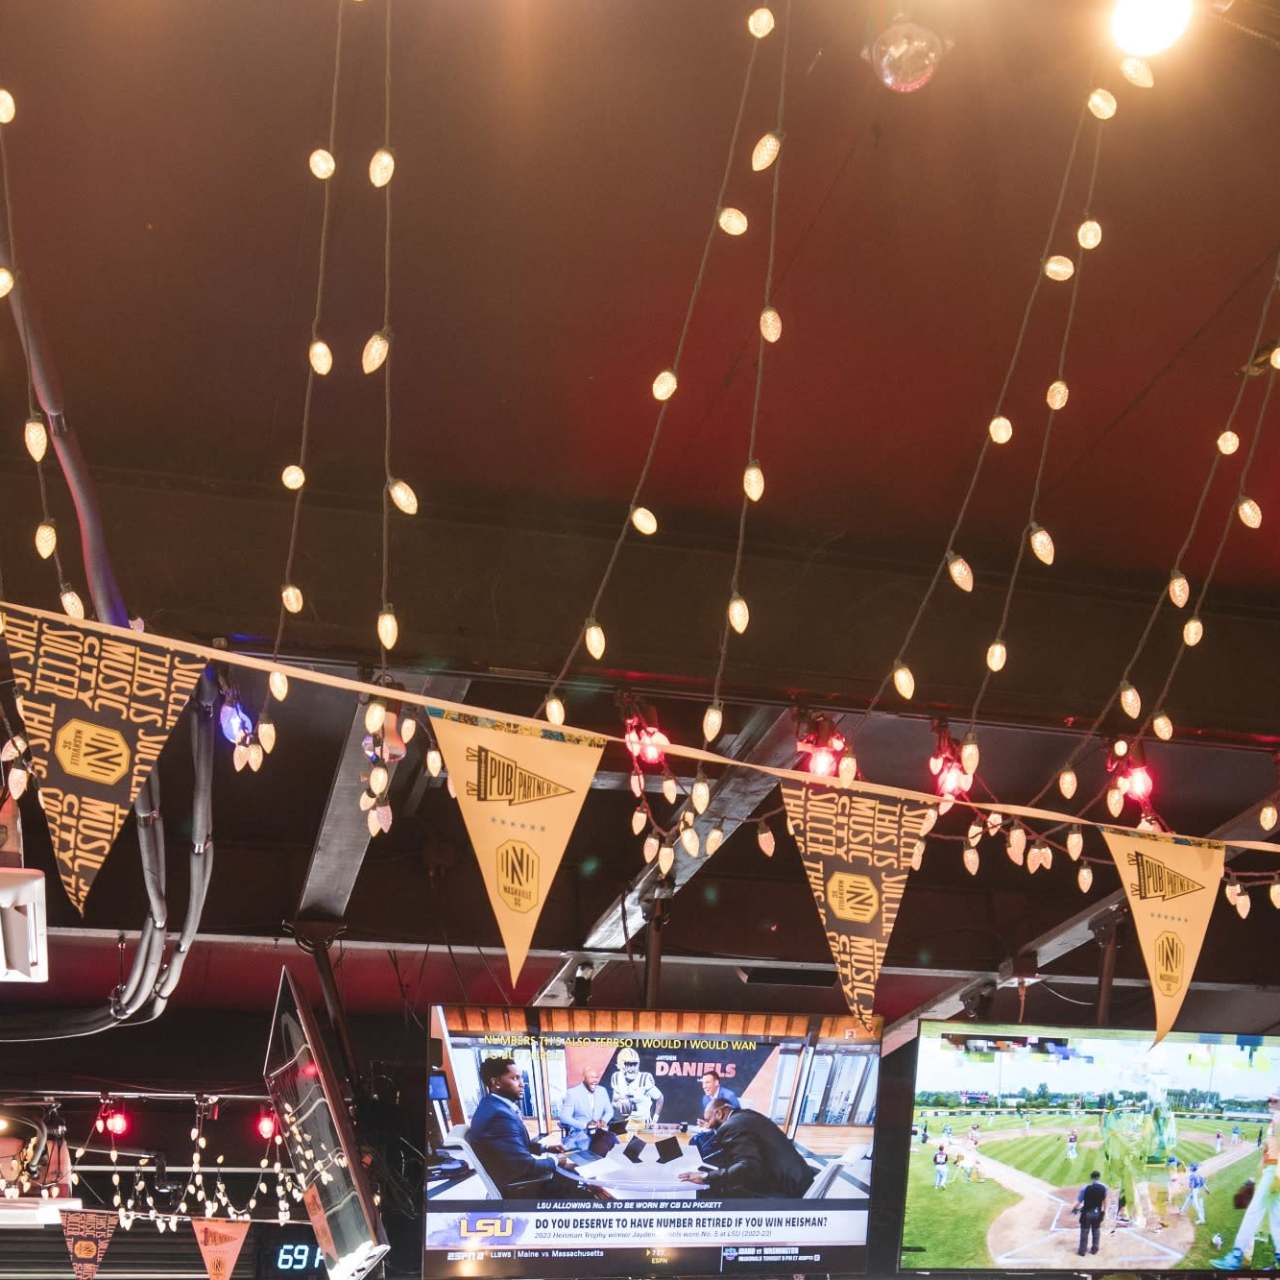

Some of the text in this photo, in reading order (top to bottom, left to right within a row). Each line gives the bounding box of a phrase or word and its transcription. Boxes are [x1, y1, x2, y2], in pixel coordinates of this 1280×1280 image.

[34, 623, 85, 700] SOCCER
[77, 636, 101, 710] CITY
[94, 638, 136, 720] MUSIC
[130, 647, 170, 702] THIS
[128, 702, 163, 728] IS
[489, 756, 552, 802] PUB PARTNER
[74, 796, 117, 872] MUSIC
[806, 788, 839, 857] SOCCER
[835, 795, 852, 864] CITY
[847, 796, 877, 867] MUSIC
[873, 800, 901, 869] THIS IS
[1144, 858, 1164, 894] PUB
[850, 934, 878, 1006] MUSIC
[642, 1038, 682, 1050] WOULD
[690, 1039, 729, 1051] WOULD
[731, 1040, 757, 1051] WAN
[655, 1061, 737, 1079] DANIELS
[458, 1217, 514, 1239] LSU
[535, 1216, 828, 1230] DO YOU DESERVE TO HAVE NUMBER RETIRED IF YOU WIN HEISMAN?
[536, 1201, 551, 1211] LSU
[552, 1202, 592, 1210] ALLOWING
[613, 1201, 623, 1210] TO
[624, 1201, 635, 1210] BE
[636, 1201, 658, 1210] WORN
[659, 1201, 669, 1210] BY
[670, 1201, 681, 1210] CB
[682, 1201, 691, 1210] DJ
[692, 1200, 723, 1210] PICKETT
[277, 1244, 309, 1270] 69
[517, 1250, 540, 1258] Maine
[551, 1249, 604, 1258] Massachusetts
[584, 1231, 607, 1240] Trophy
[632, 1231, 656, 1240] Jayden
